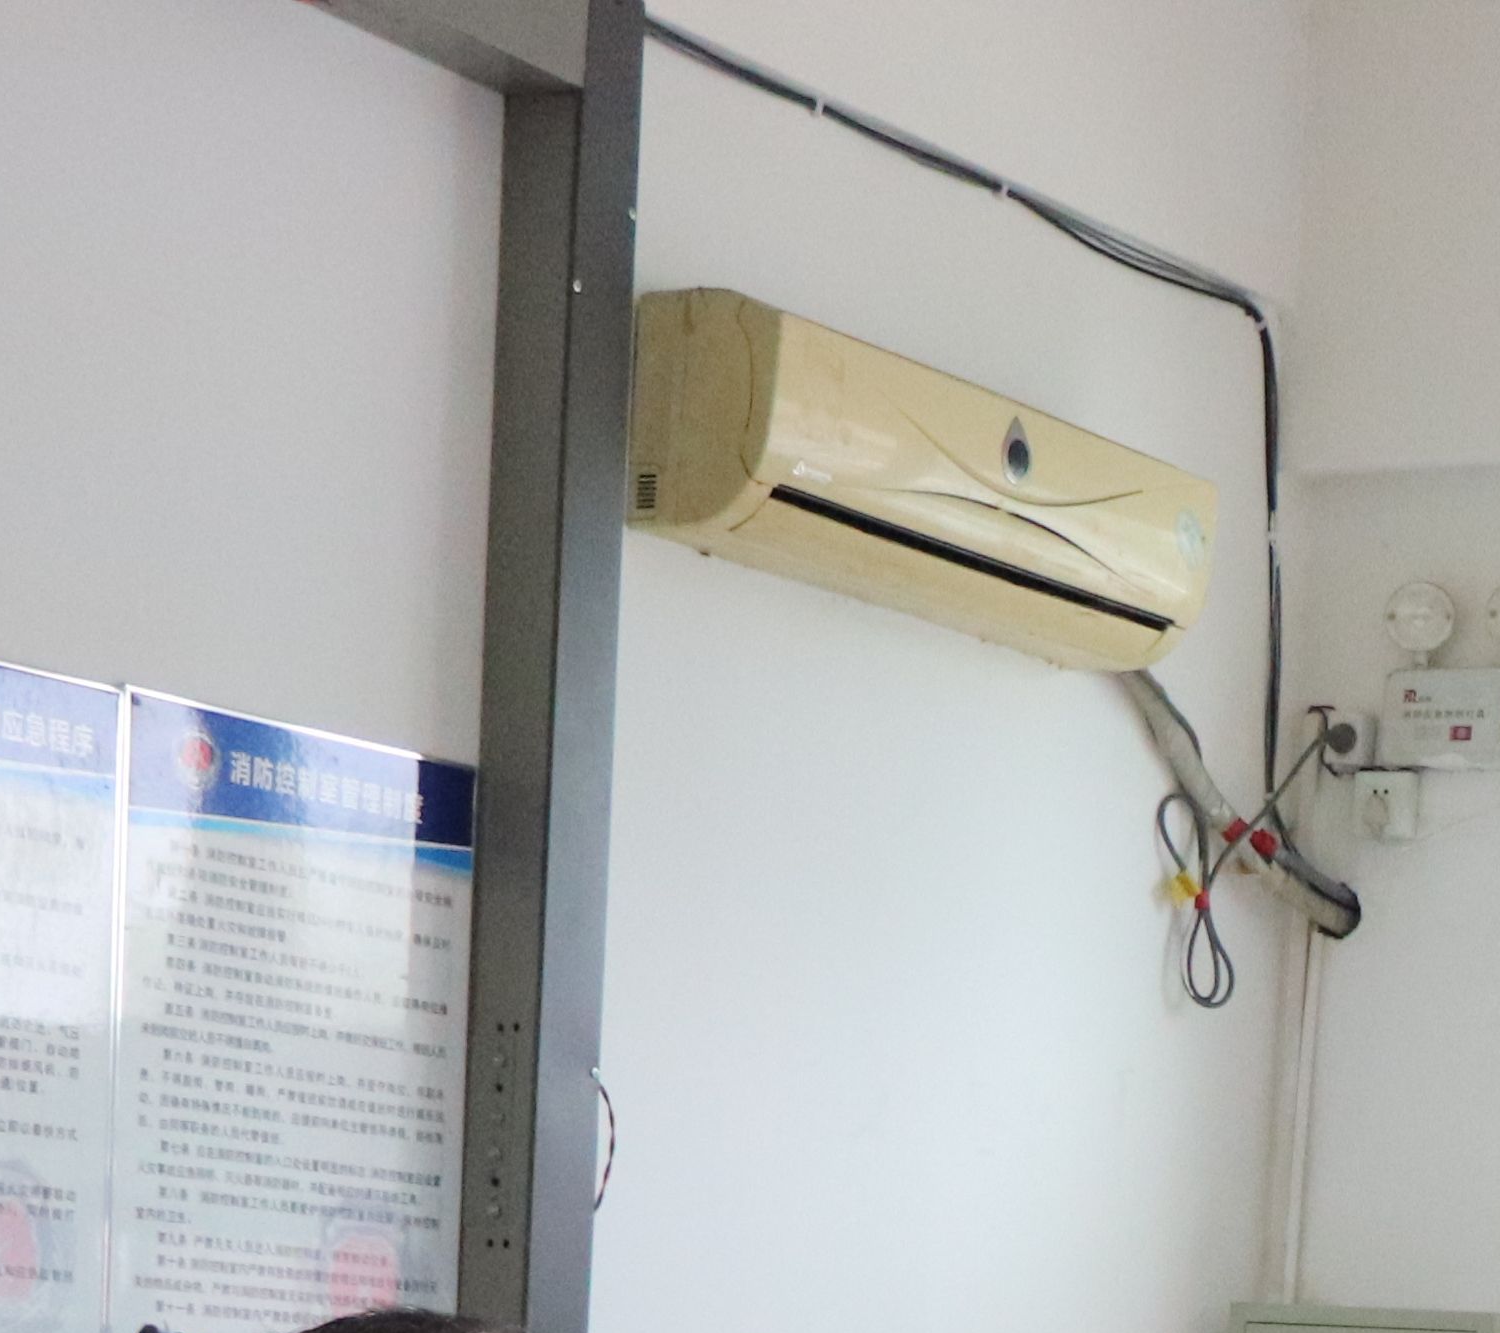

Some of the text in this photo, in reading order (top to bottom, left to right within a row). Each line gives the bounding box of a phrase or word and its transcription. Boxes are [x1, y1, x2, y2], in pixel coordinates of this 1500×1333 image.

[228, 750, 424, 825] 消防控制室管理制度
